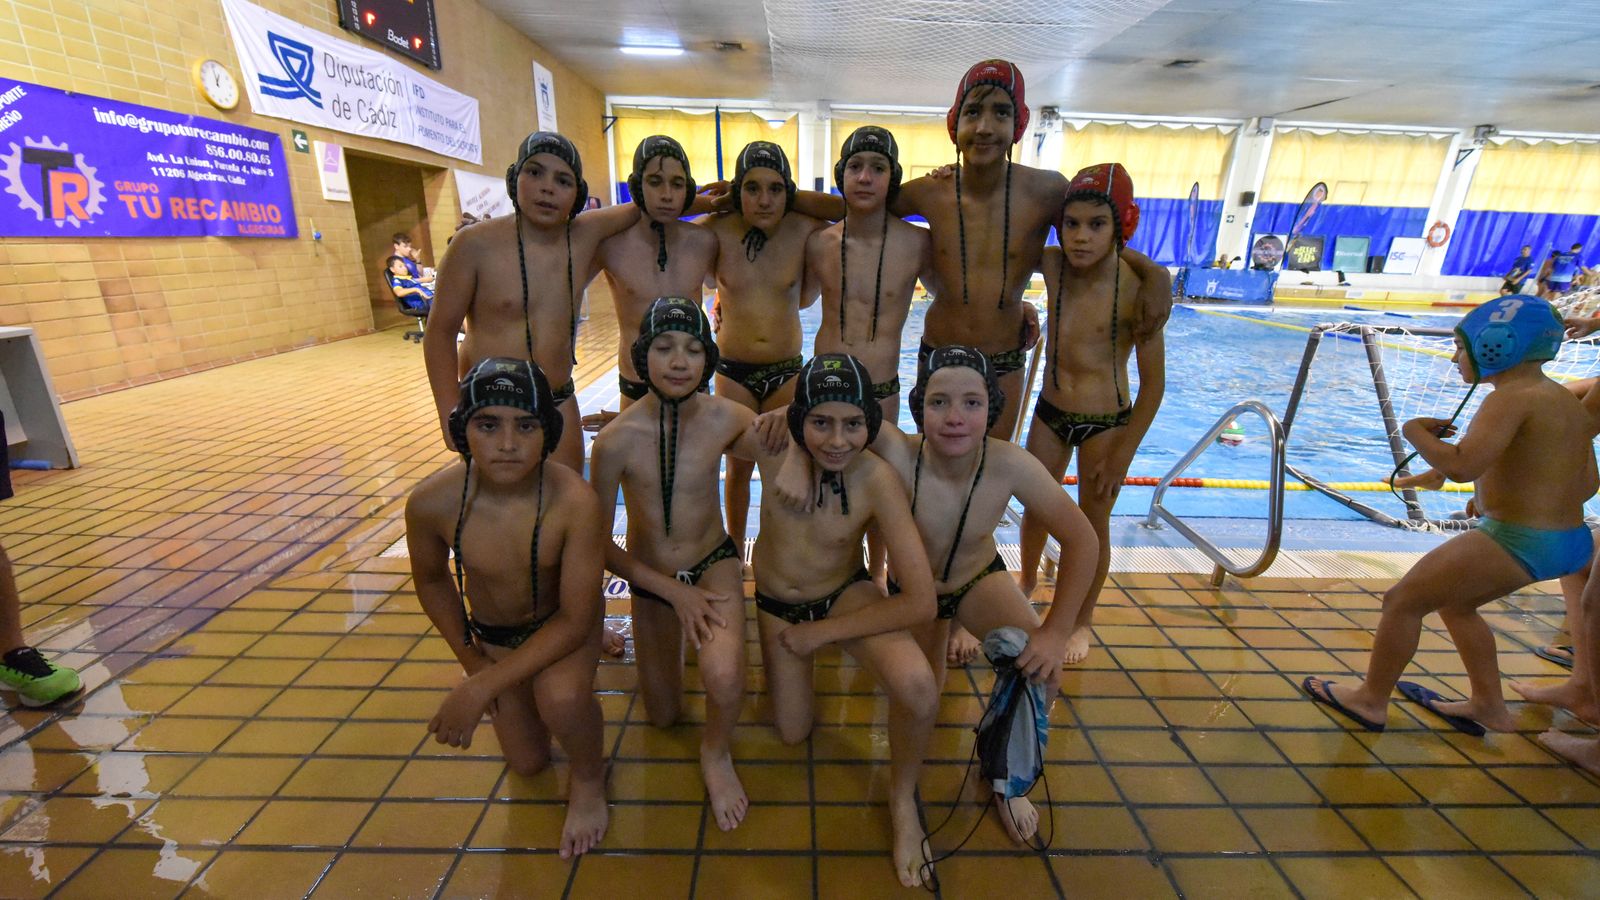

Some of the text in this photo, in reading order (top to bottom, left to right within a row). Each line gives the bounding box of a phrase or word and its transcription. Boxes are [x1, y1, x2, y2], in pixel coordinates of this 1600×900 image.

[323, 52, 404, 99] Diputación
[412, 83, 426, 99] IFD
[332, 92, 398, 129] de Cádiz
[93, 107, 270, 151] info@grupoturecambio.com
[146, 151, 169, 163] Avd.
[169, 154, 184, 165] La
[114, 180, 160, 194] GRUPO
[118, 194, 282, 223] TU RECAMBIO
[1489, 299, 1524, 323] 3
[485, 384, 524, 394] TURBO
[817, 381, 850, 389] TURBO
